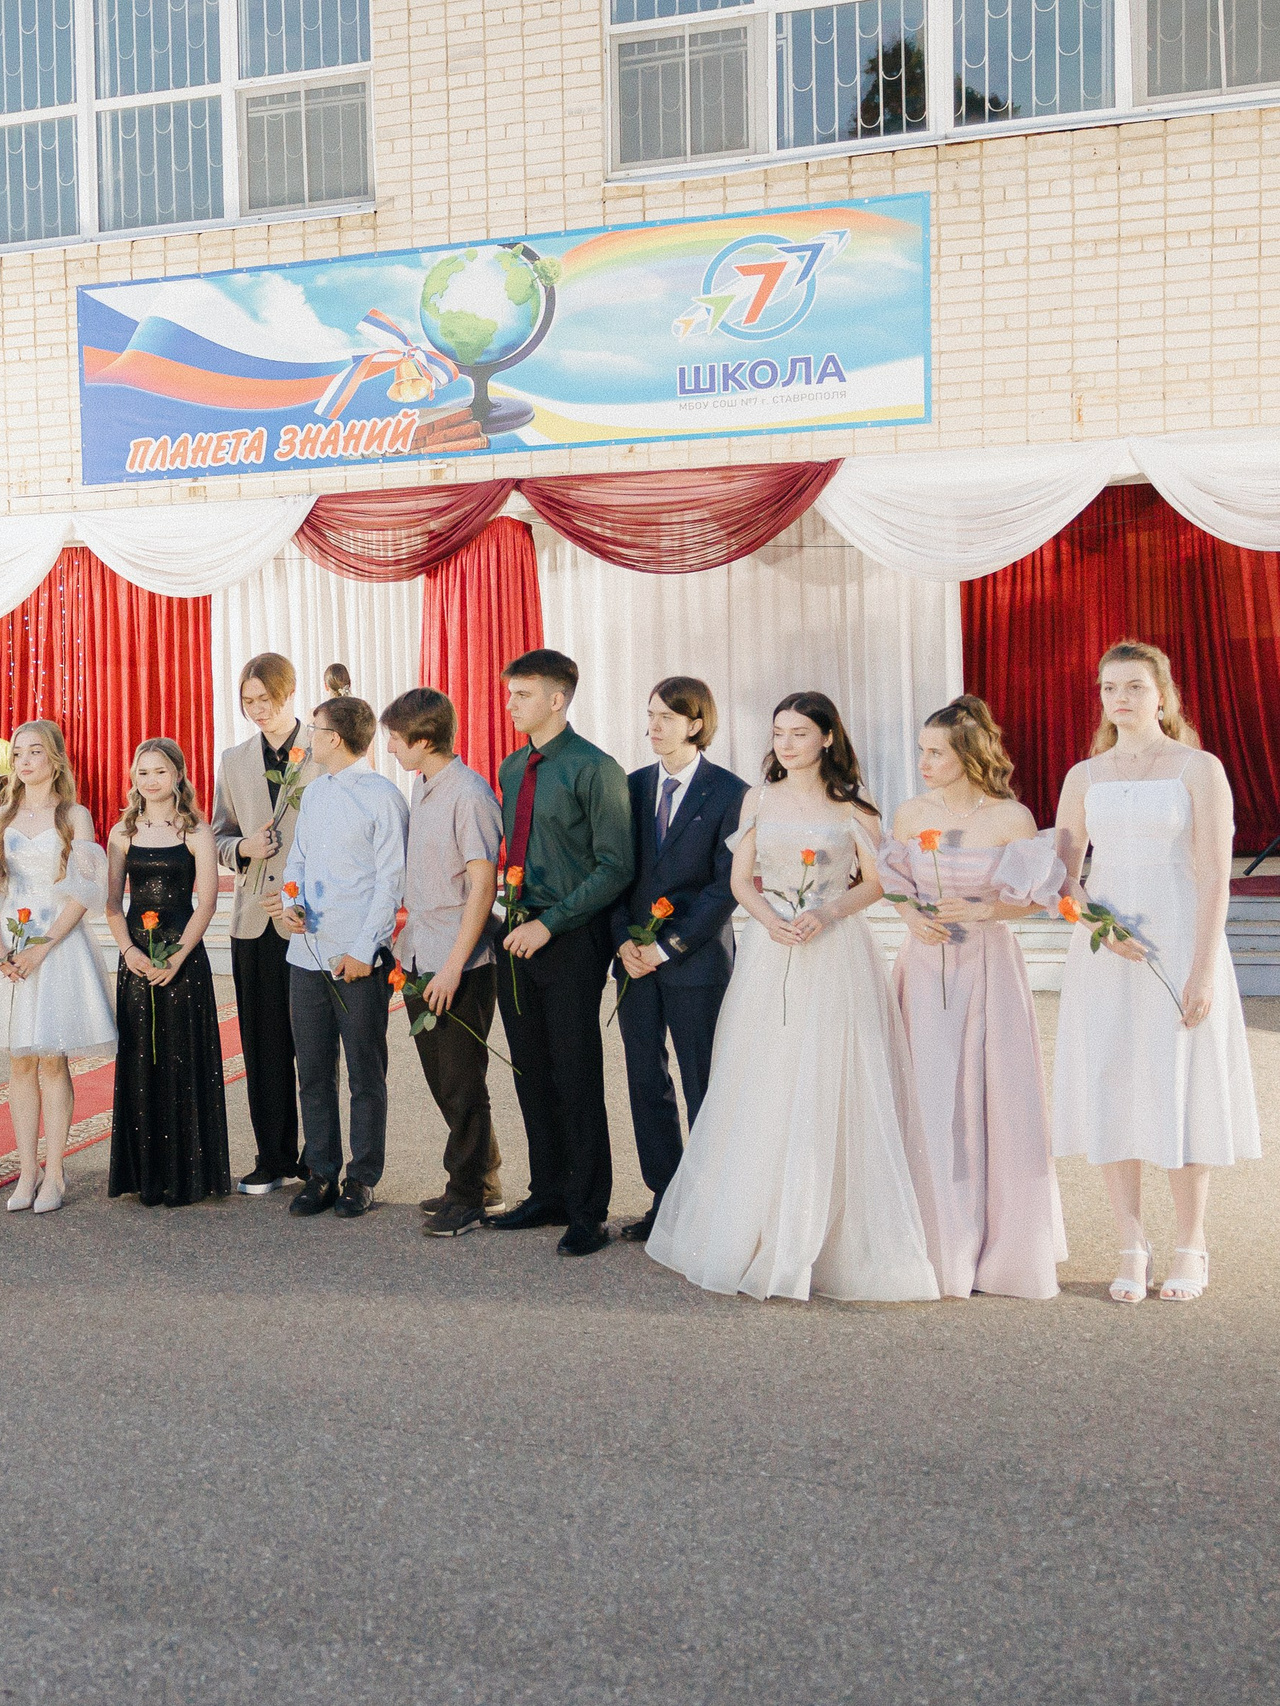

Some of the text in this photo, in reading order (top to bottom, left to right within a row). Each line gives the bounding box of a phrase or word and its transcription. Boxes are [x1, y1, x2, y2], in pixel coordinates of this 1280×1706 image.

[678, 353, 847, 395] ШКОЛА
[679, 401, 709, 412] МБОУ
[712, 399, 737, 409] СОШ
[772, 390, 847, 404] СТАВРОПОЛЯ
[127, 410, 419, 472] ПЛАНЕТА ЗНАНИЙ
